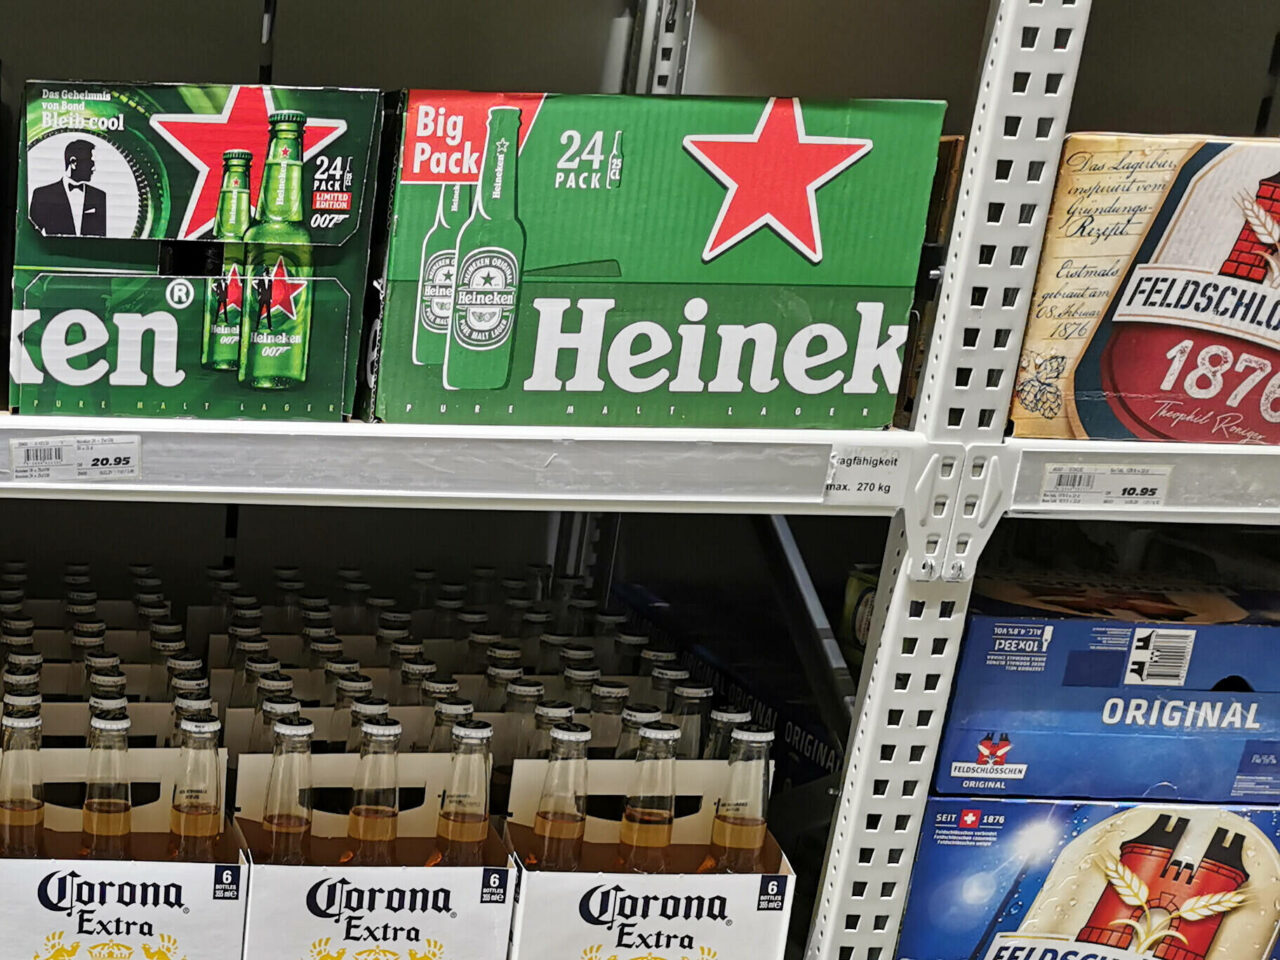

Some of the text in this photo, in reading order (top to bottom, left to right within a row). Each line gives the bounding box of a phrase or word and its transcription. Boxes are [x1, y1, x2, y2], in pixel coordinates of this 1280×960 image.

[42, 89, 111, 101] Das Geheimnis
[42, 101, 85, 111] von Bond
[42, 112, 124, 131] Bleib cool
[416, 105, 464, 146] Big
[413, 141, 479, 174] Pack
[557, 130, 604, 170] 24
[314, 156, 342, 179] 24
[1066, 151, 1105, 172] Das
[314, 180, 341, 191] PACK
[555, 171, 600, 190] PACK
[1137, 181, 1167, 191] vom
[316, 193, 349, 201] LIMITED
[316, 200, 348, 209] EDITION
[311, 214, 337, 228] 007
[1056, 259, 1119, 279] Erstmals
[458, 291, 513, 305] Heineken
[1038, 282, 1109, 307] gebraut am
[250, 332, 302, 344] Heineken
[1050, 320, 1091, 340] 1876
[523, 297, 909, 394] Heinek
[91, 456, 131, 467] 20.95
[1121, 487, 1157, 496] 10.95
[1102, 698, 1261, 730] ORIGINAL
[936, 813, 1005, 824] SEIT 1876
[223, 870, 233, 883] 6
[37, 869, 185, 916] Corona
[306, 877, 452, 923] Corona
[579, 884, 727, 930] Corona
[77, 909, 154, 938] Extra
[344, 915, 420, 943] Extra
[615, 922, 694, 950] Extra
